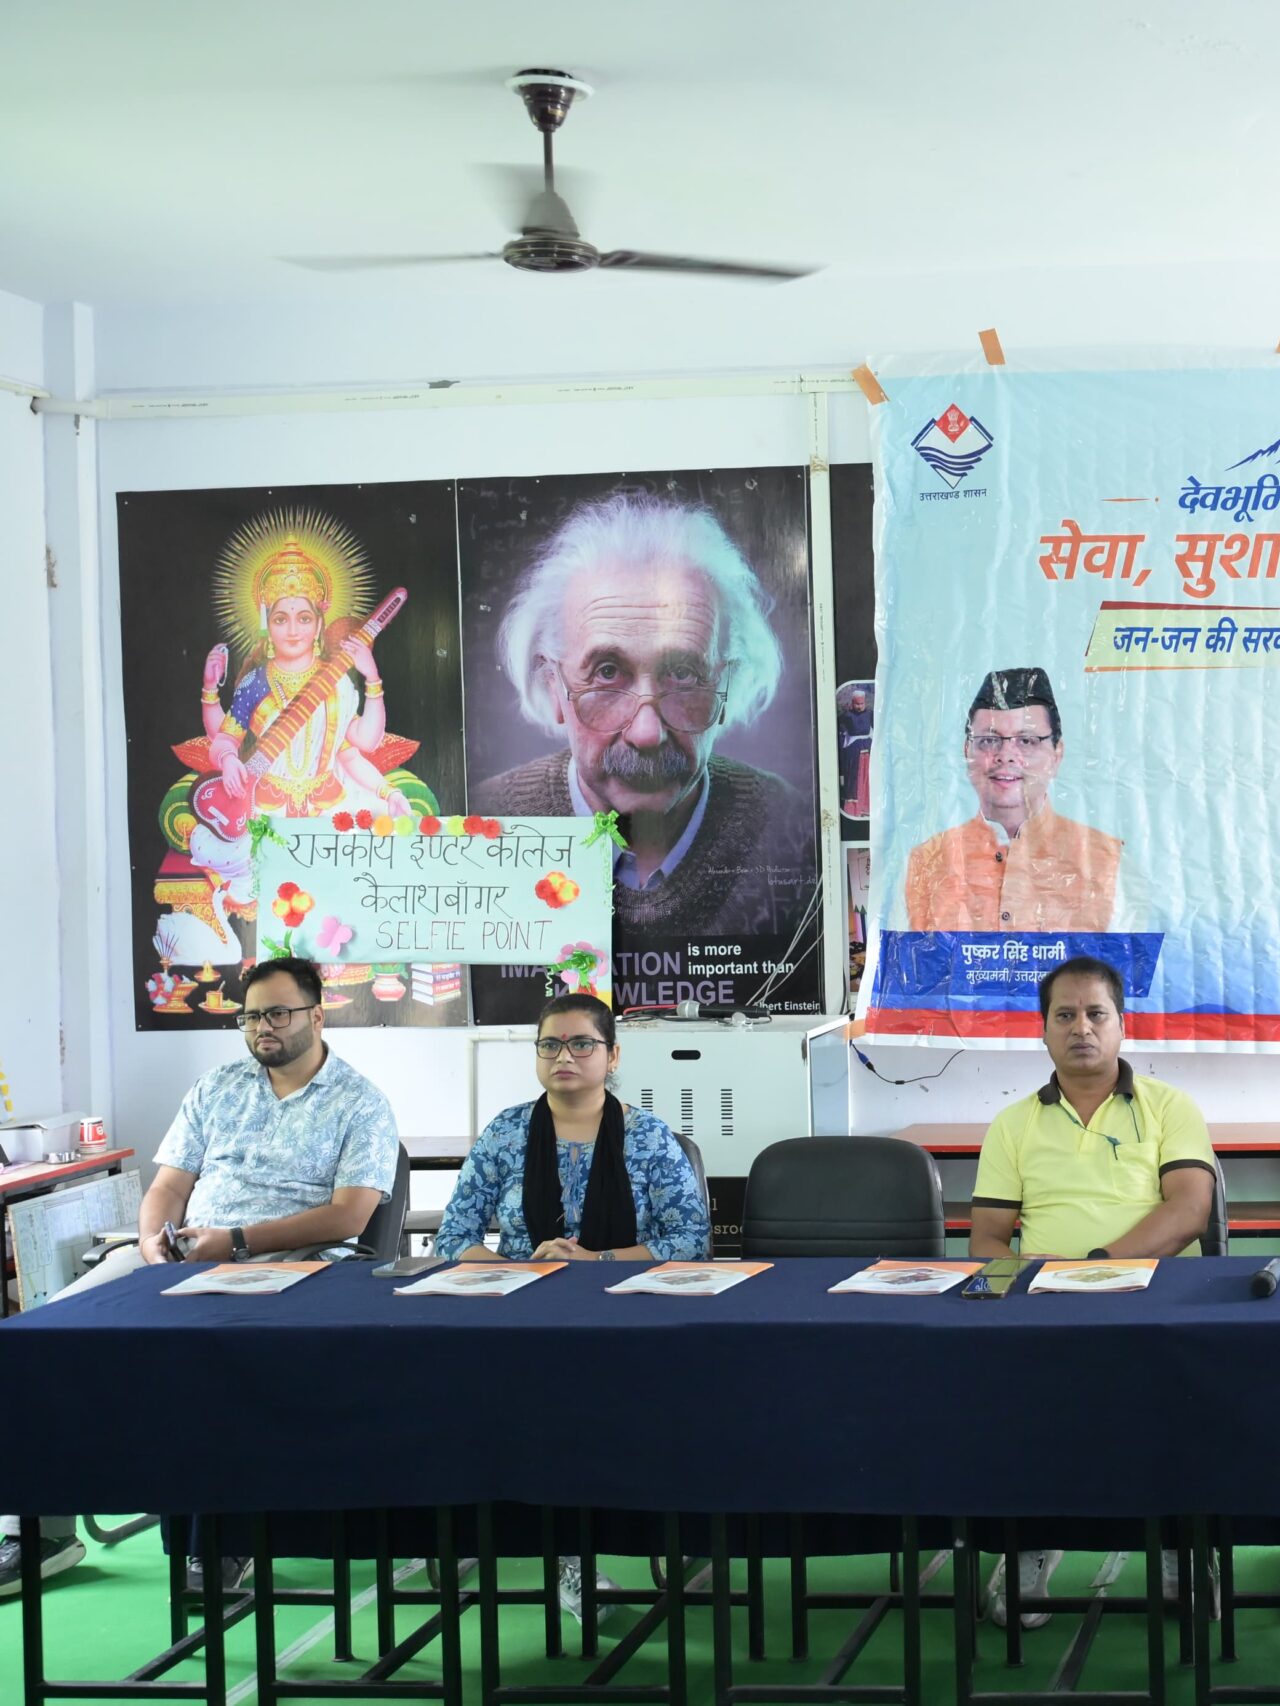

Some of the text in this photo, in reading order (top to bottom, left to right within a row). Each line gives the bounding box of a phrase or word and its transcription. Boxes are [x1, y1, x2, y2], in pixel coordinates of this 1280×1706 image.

[919, 488, 987, 502] उत्तराखण्ड शासन
[1039, 520, 1153, 587] सेवा,
[1113, 626, 1202, 653] जन-जन
[1206, 617, 1238, 653] की
[486, 824, 577, 869] कॉलेज
[375, 919, 553, 951] SELFIE POINT
[687, 943, 700, 956] is
[704, 945, 742, 956] more
[961, 940, 1067, 965] पुष्कर सिंह धामी
[688, 960, 795, 977] important than
